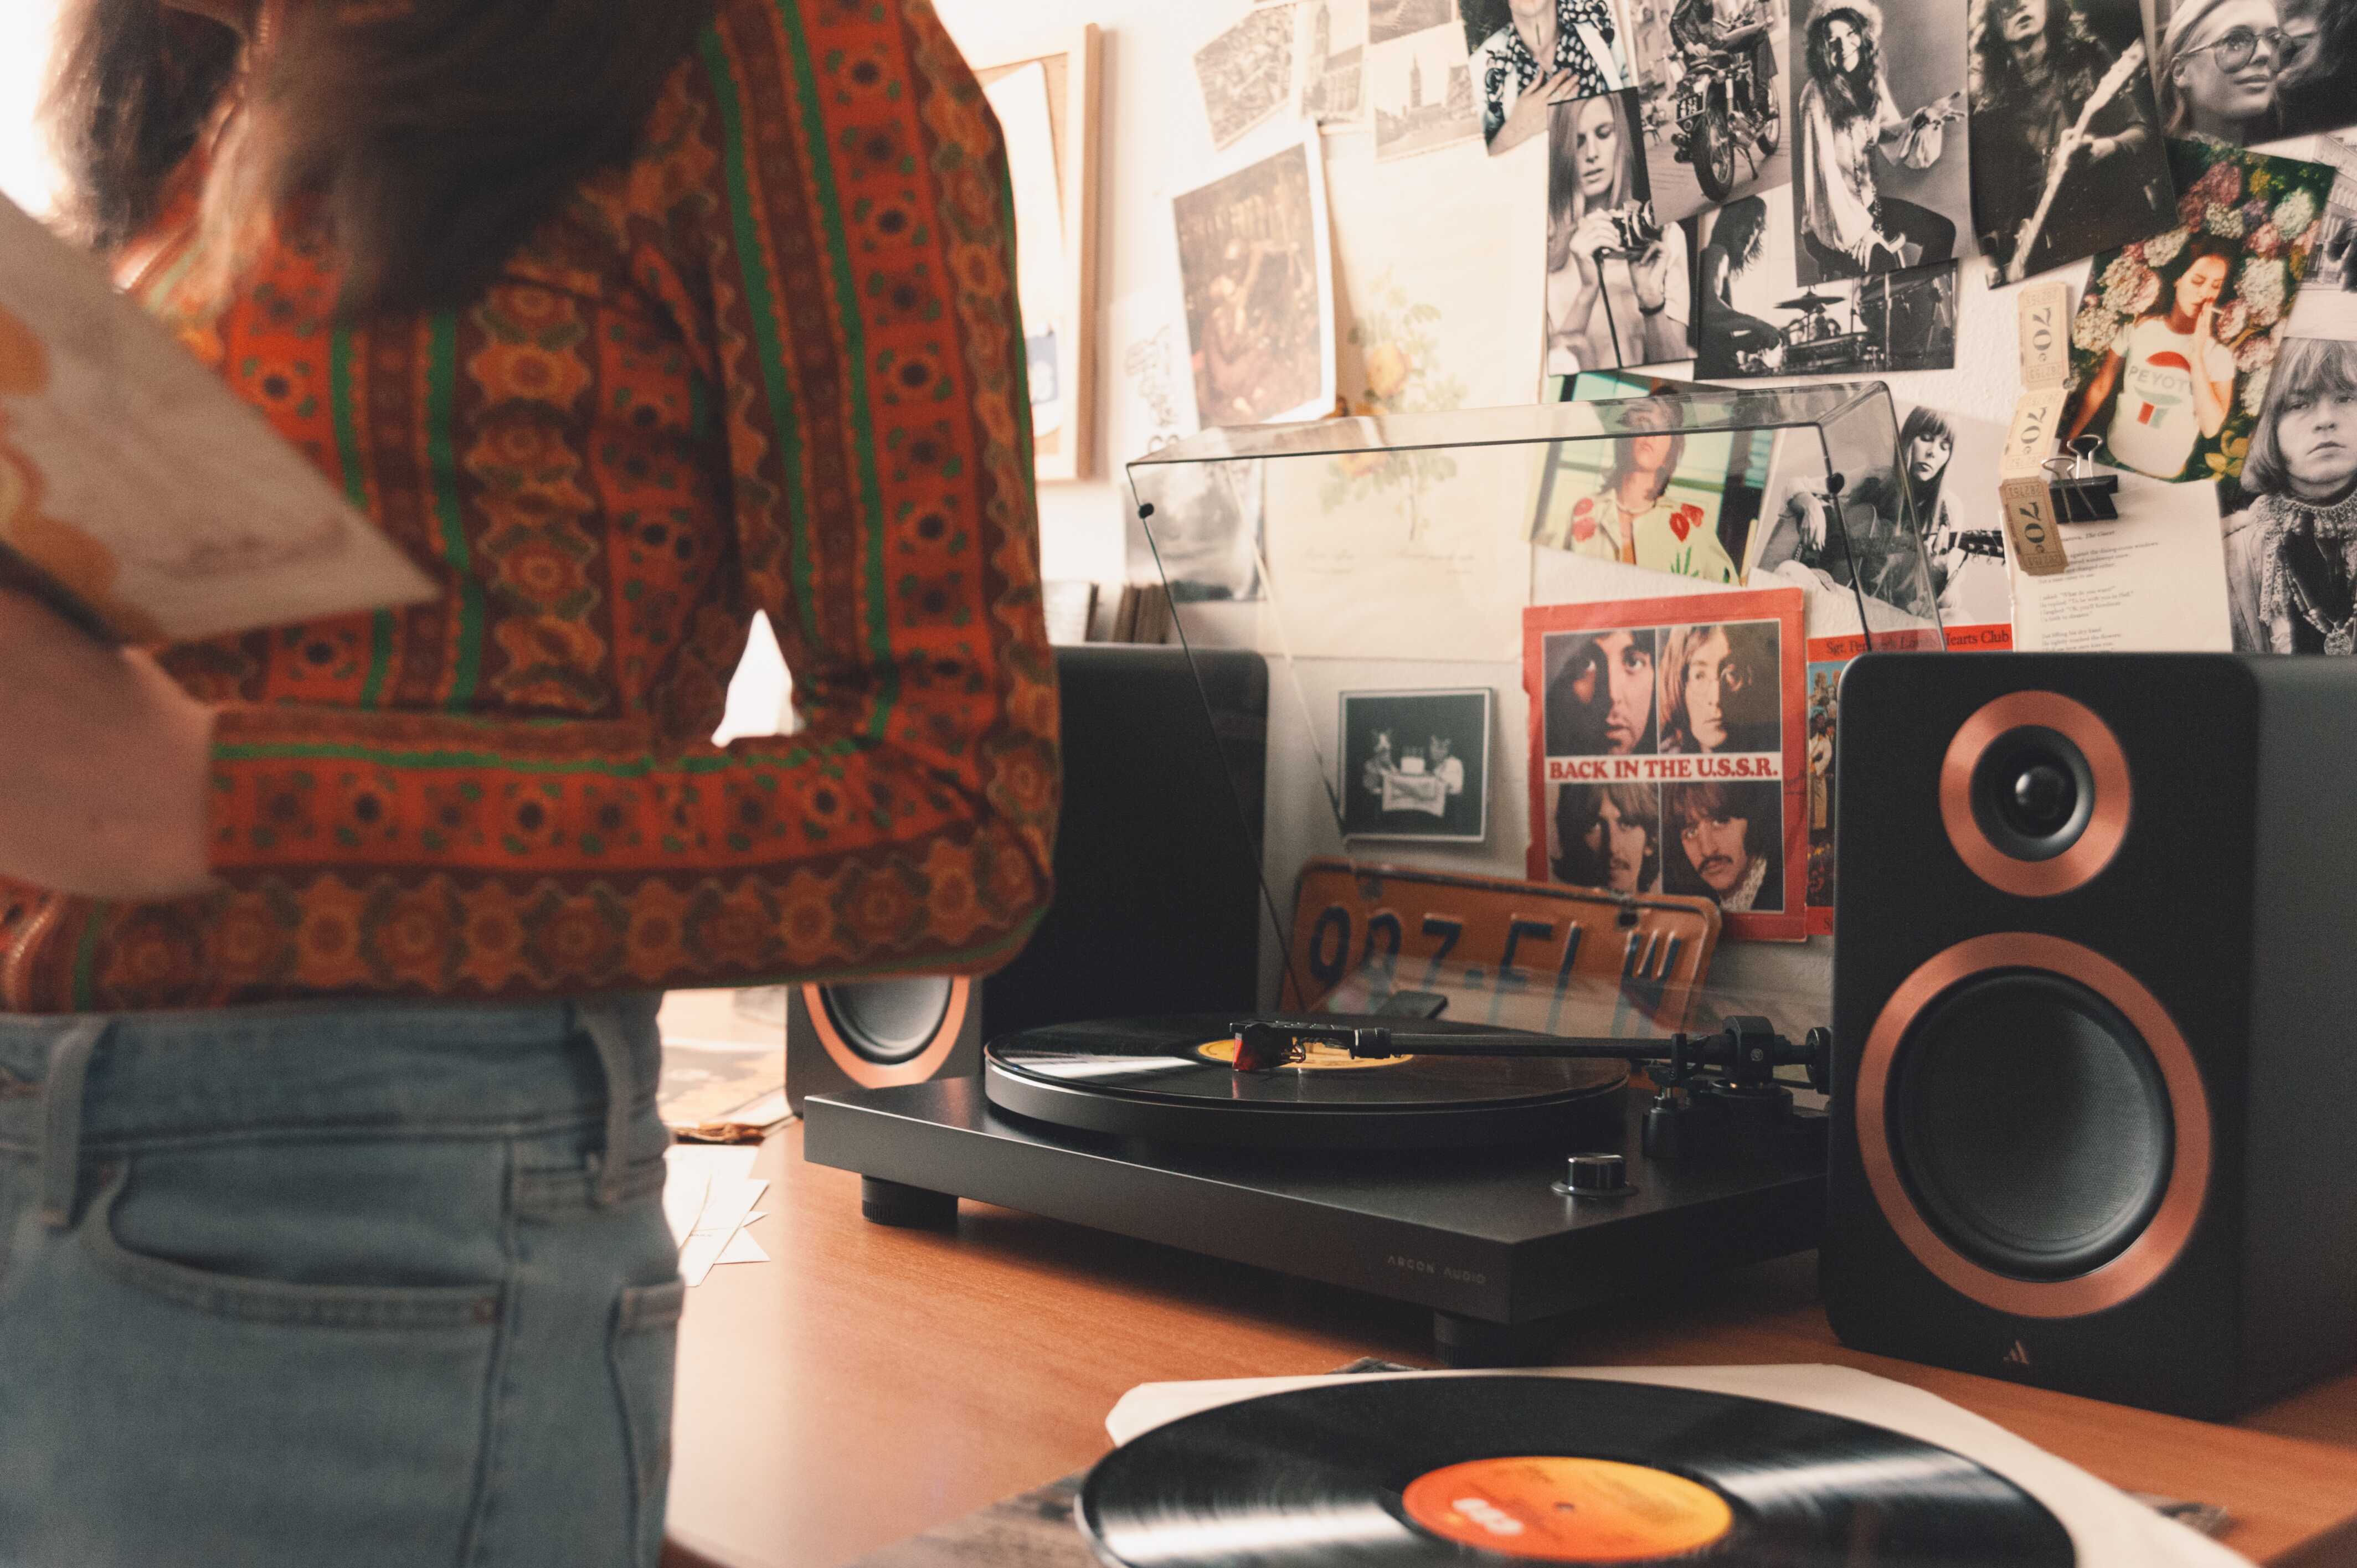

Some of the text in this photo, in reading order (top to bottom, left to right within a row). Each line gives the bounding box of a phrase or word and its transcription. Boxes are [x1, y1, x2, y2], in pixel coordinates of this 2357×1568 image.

[2128, 365, 2190, 392] PEYOT
[1980, 629, 2010, 643] Club
[1549, 757, 1779, 780] BACK IN THE U.S.S.R.
[1387, 1255, 1435, 1273] ARGON
